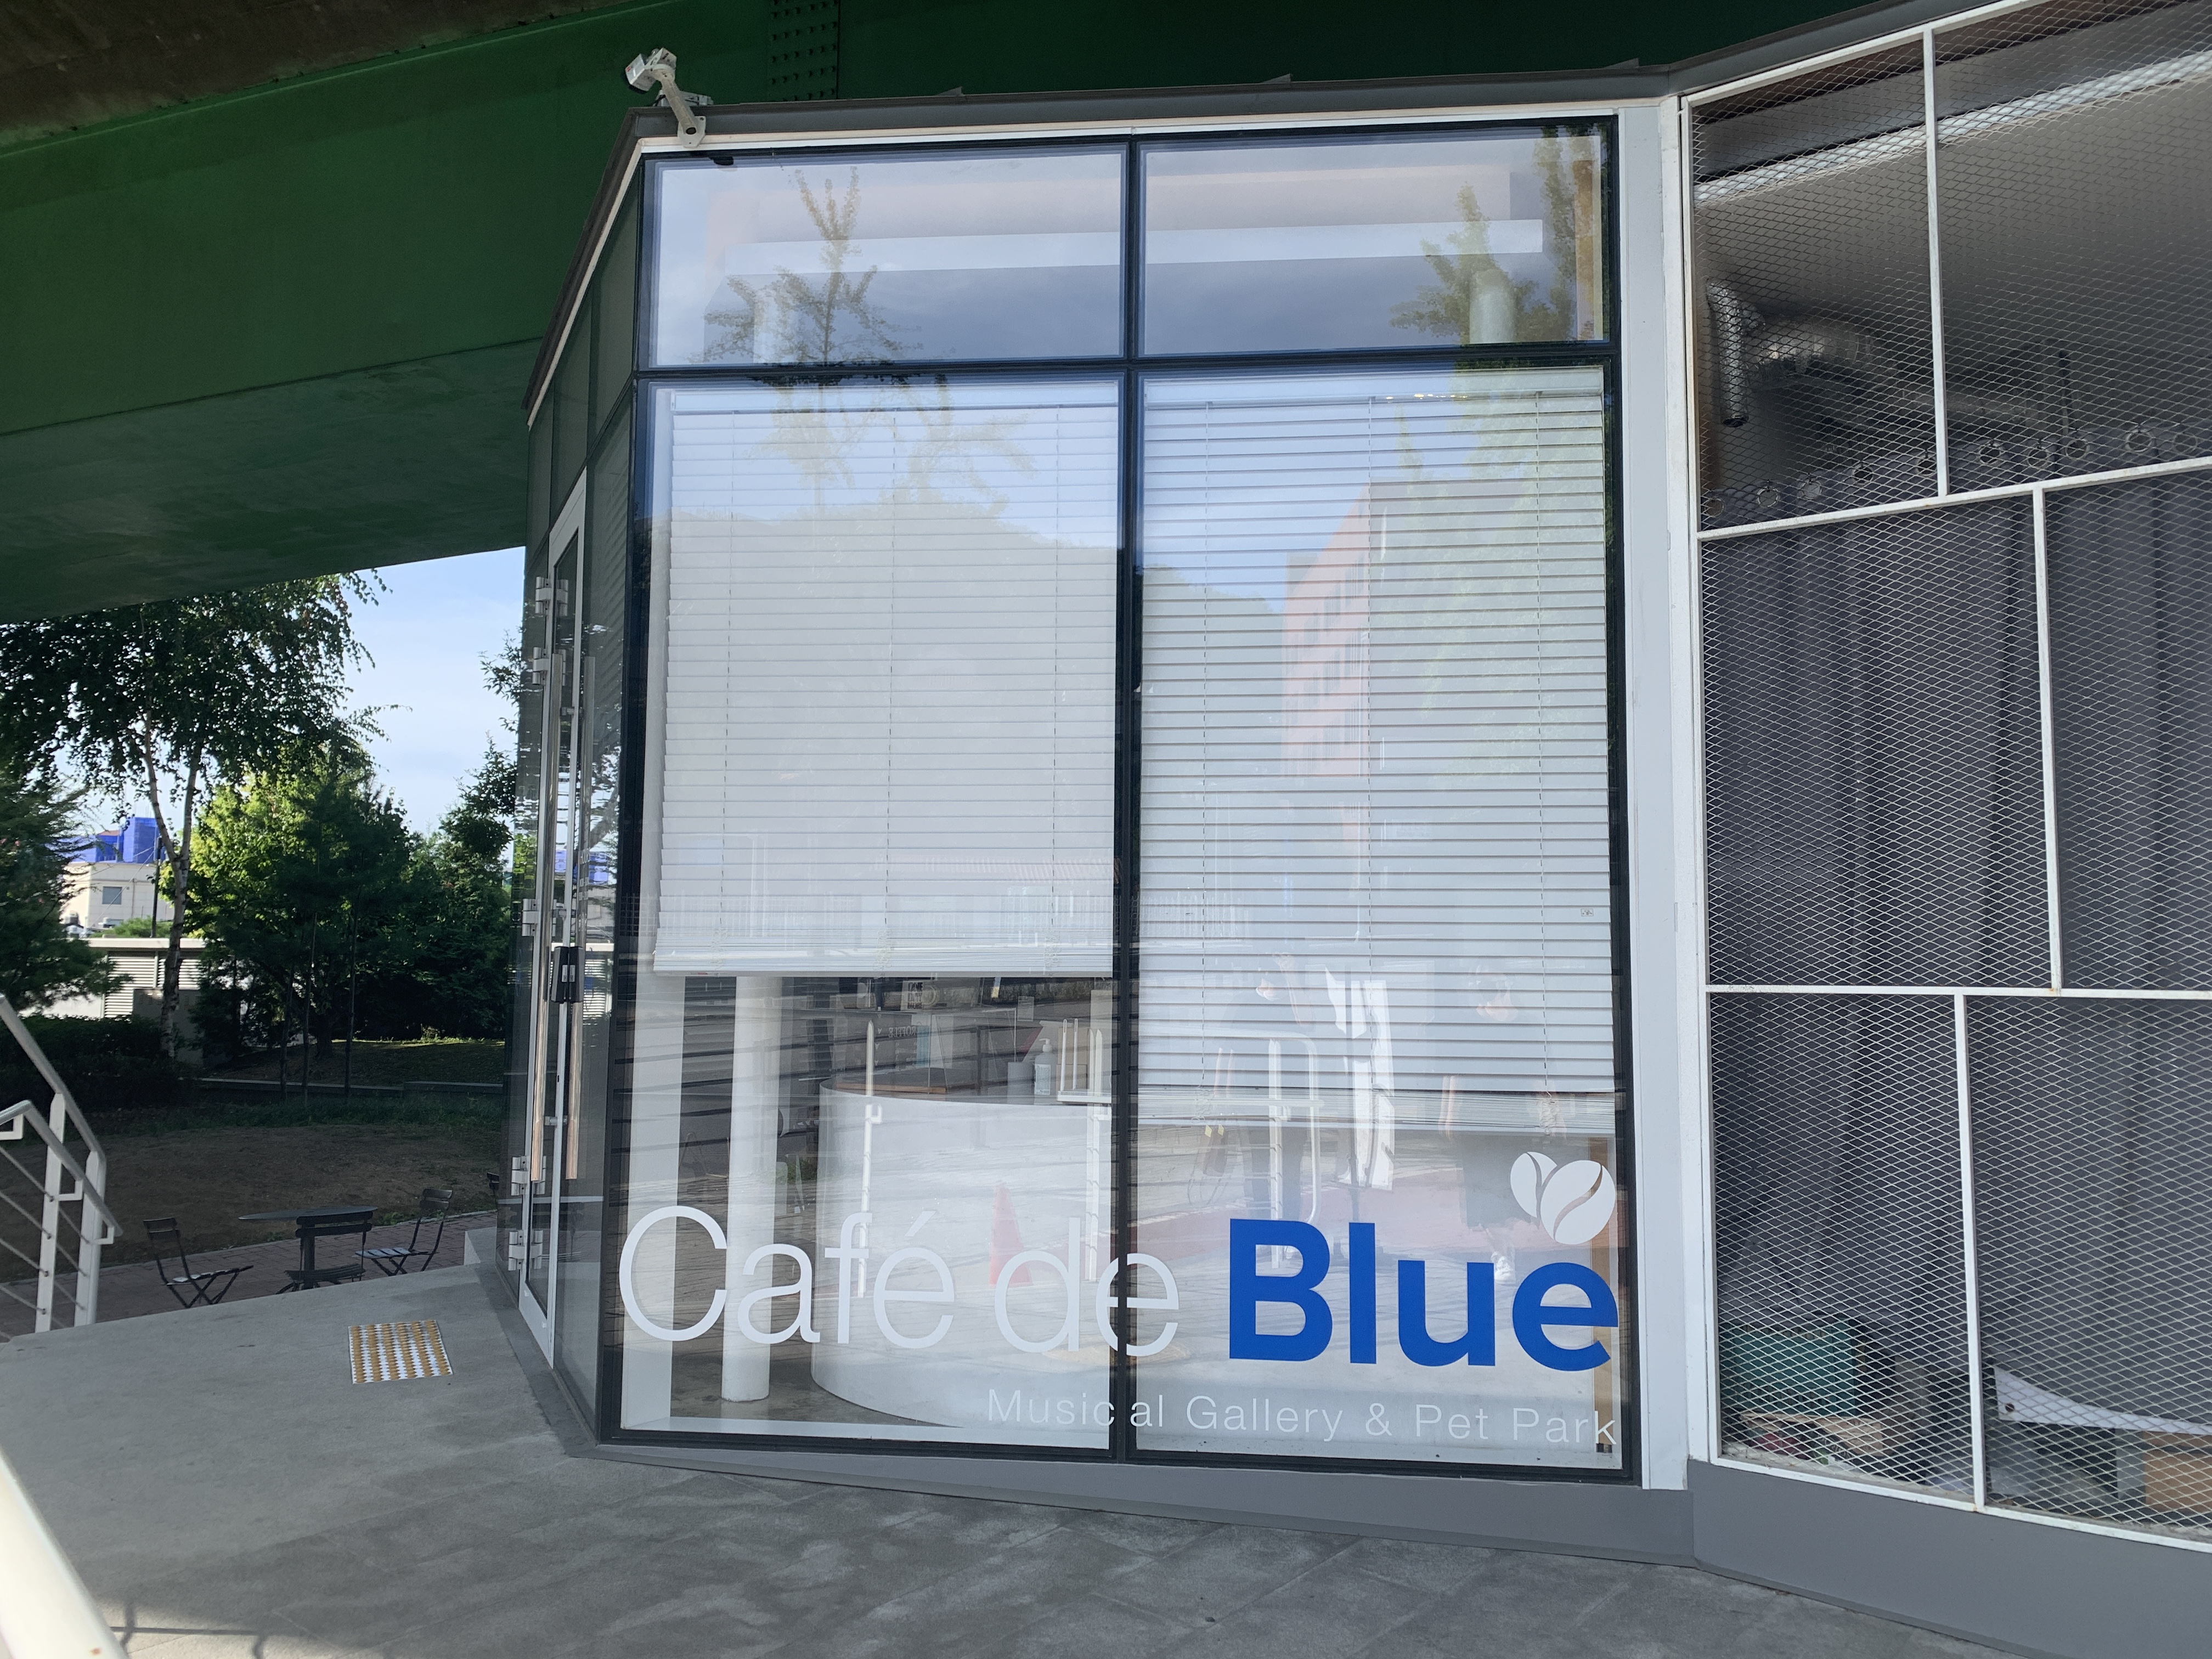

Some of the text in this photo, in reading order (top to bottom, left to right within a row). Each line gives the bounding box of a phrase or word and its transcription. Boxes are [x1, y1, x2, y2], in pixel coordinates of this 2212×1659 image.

[619, 1206, 1618, 1372] Café de Blue
[1186, 1395, 1342, 1442] Gallery
[1365, 1402, 1392, 1436] &
[1415, 1403, 1488, 1440] Pet
[1513, 1407, 1617, 1445] Park
